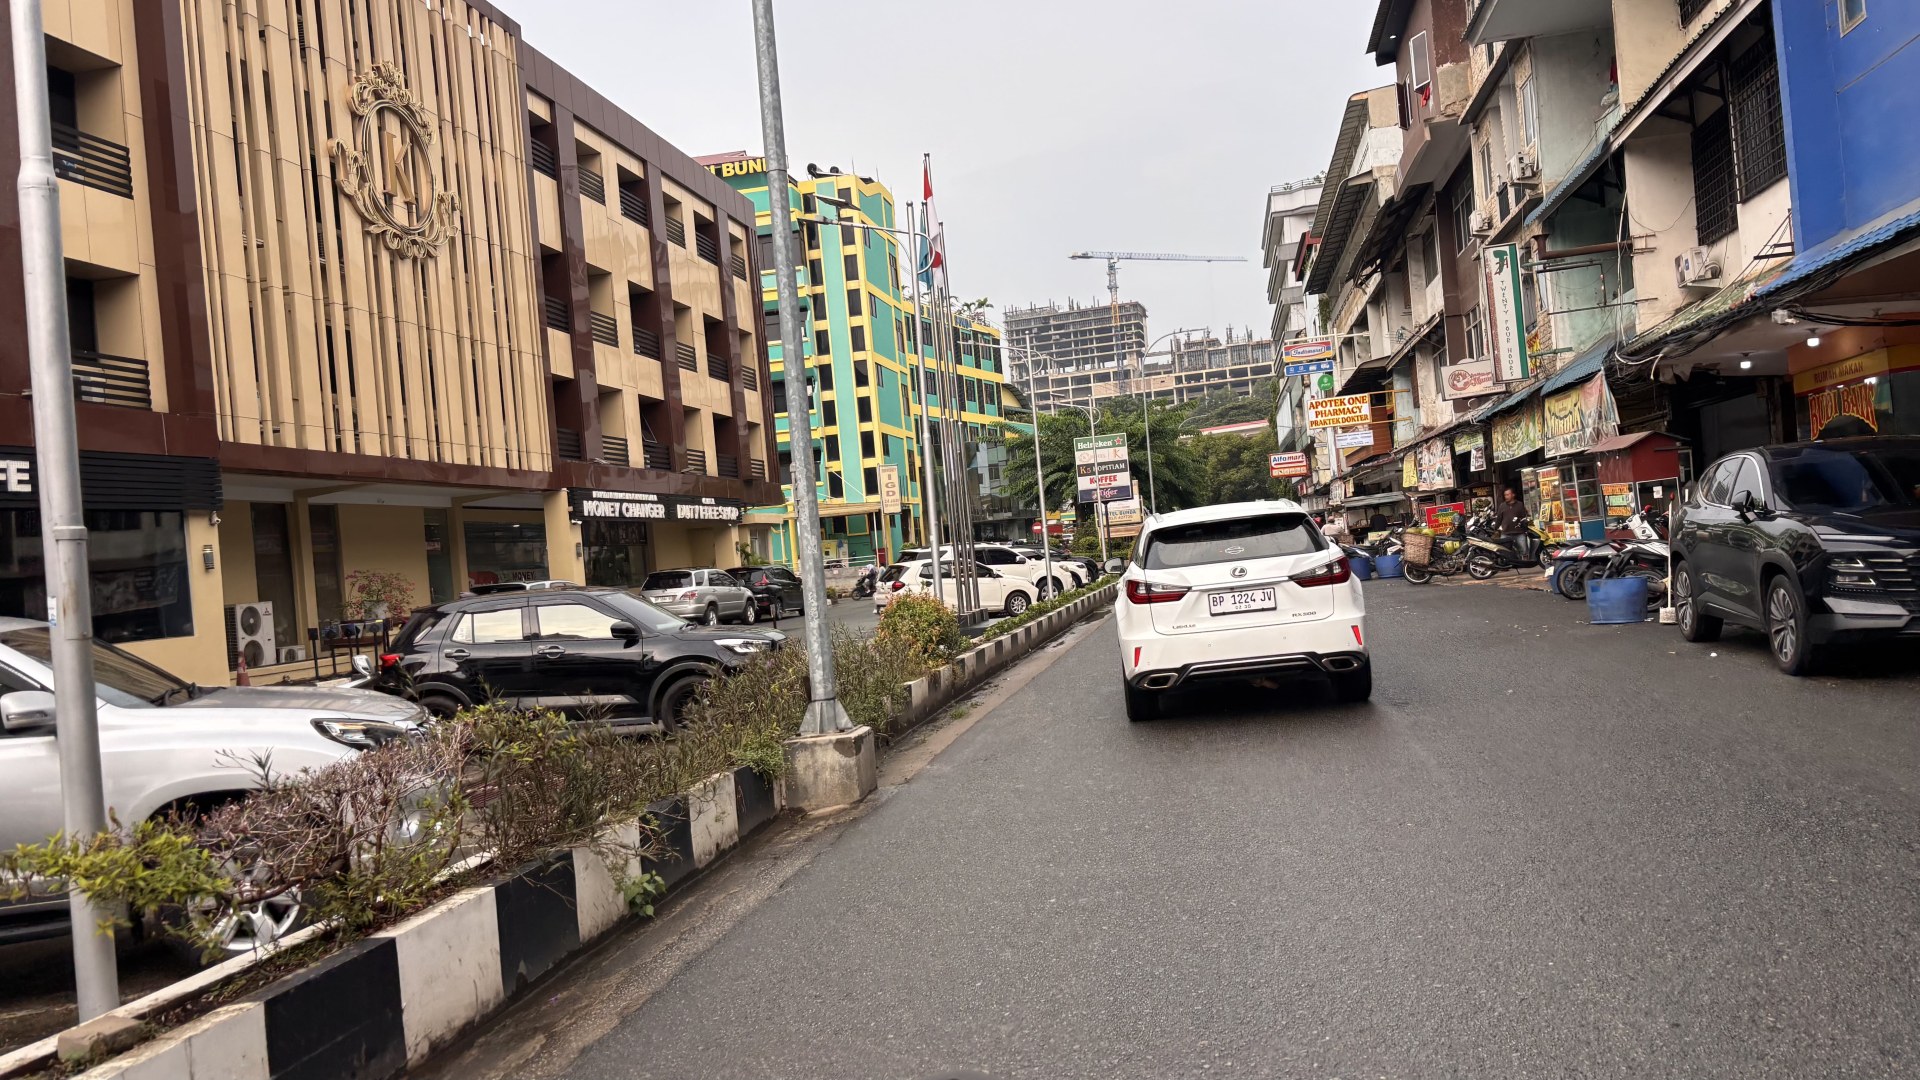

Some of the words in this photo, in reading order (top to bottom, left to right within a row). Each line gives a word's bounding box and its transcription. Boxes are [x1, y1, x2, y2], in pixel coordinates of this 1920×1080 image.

[721, 158, 766, 177] BUN
[1309, 398, 1346, 410] APOTEK
[1347, 395, 1368, 406] ONE
[1315, 405, 1363, 419] PHARMACY
[1310, 417, 1341, 428] PRAKTEK
[1341, 414, 1369, 424] DOKTER
[583, 500, 620, 517] MONEY
[621, 502, 665, 519] CHANGER
[677, 503, 699, 520] DUTY
[512, 571, 535, 581] MONEY
[1212, 596, 1225, 607] BP
[1231, 592, 1256, 605] 1224
[1260, 590, 1272, 602] JV
